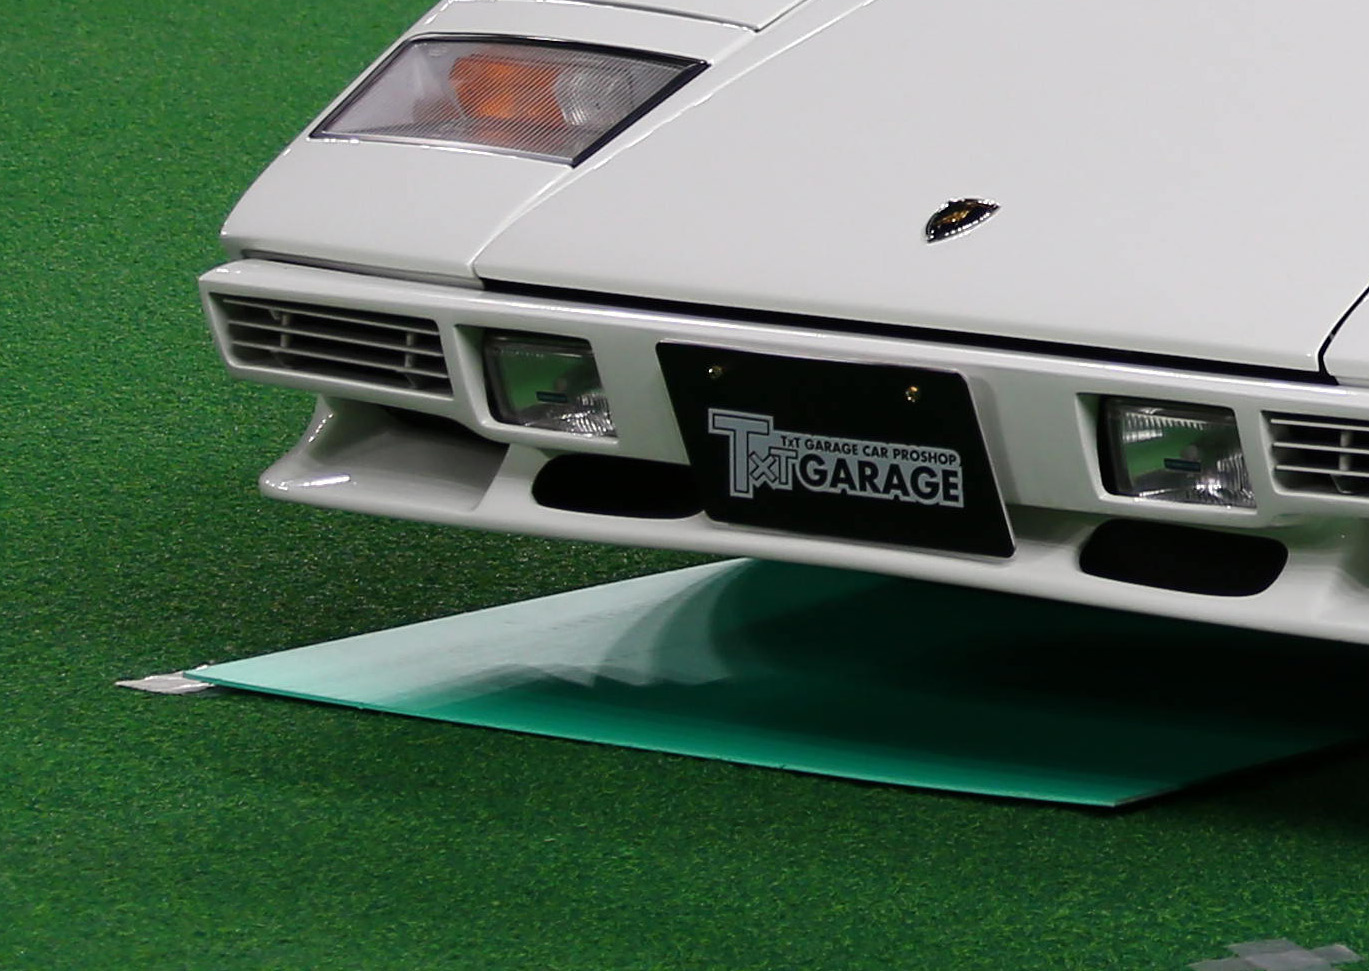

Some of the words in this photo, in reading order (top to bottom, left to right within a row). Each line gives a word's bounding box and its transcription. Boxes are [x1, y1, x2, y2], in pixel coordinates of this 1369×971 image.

[804, 439, 859, 456] GARAGE
[862, 445, 889, 460] CAR
[892, 450, 957, 466] PROSHOP
[799, 452, 961, 504] GARAGE
